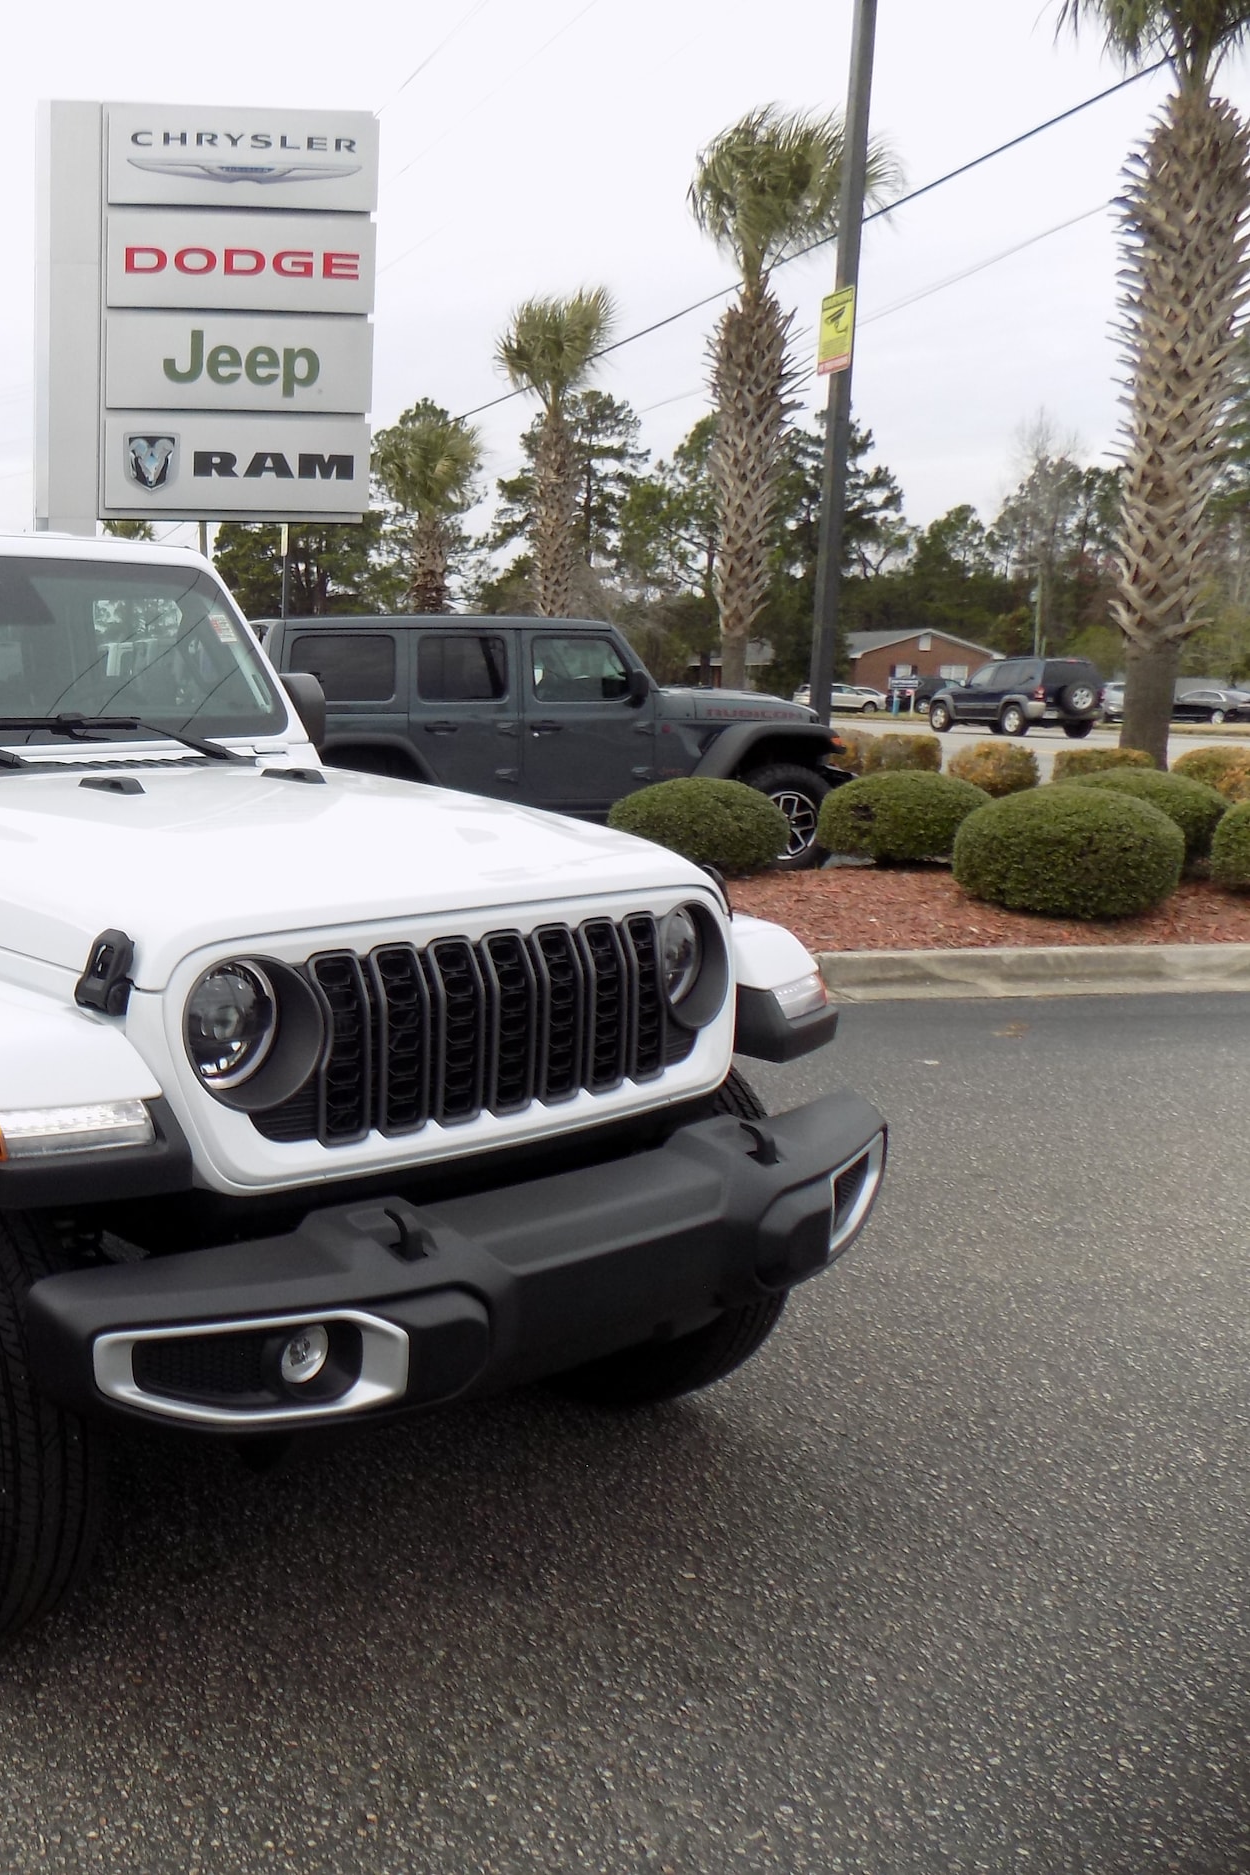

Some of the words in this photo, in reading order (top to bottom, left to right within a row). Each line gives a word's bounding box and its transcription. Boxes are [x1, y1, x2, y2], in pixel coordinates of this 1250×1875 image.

[130, 131, 357, 154] CHRYSLER
[124, 246, 360, 280] DODGE
[162, 330, 320, 398] Jeep
[193, 450, 354, 481] RAM
